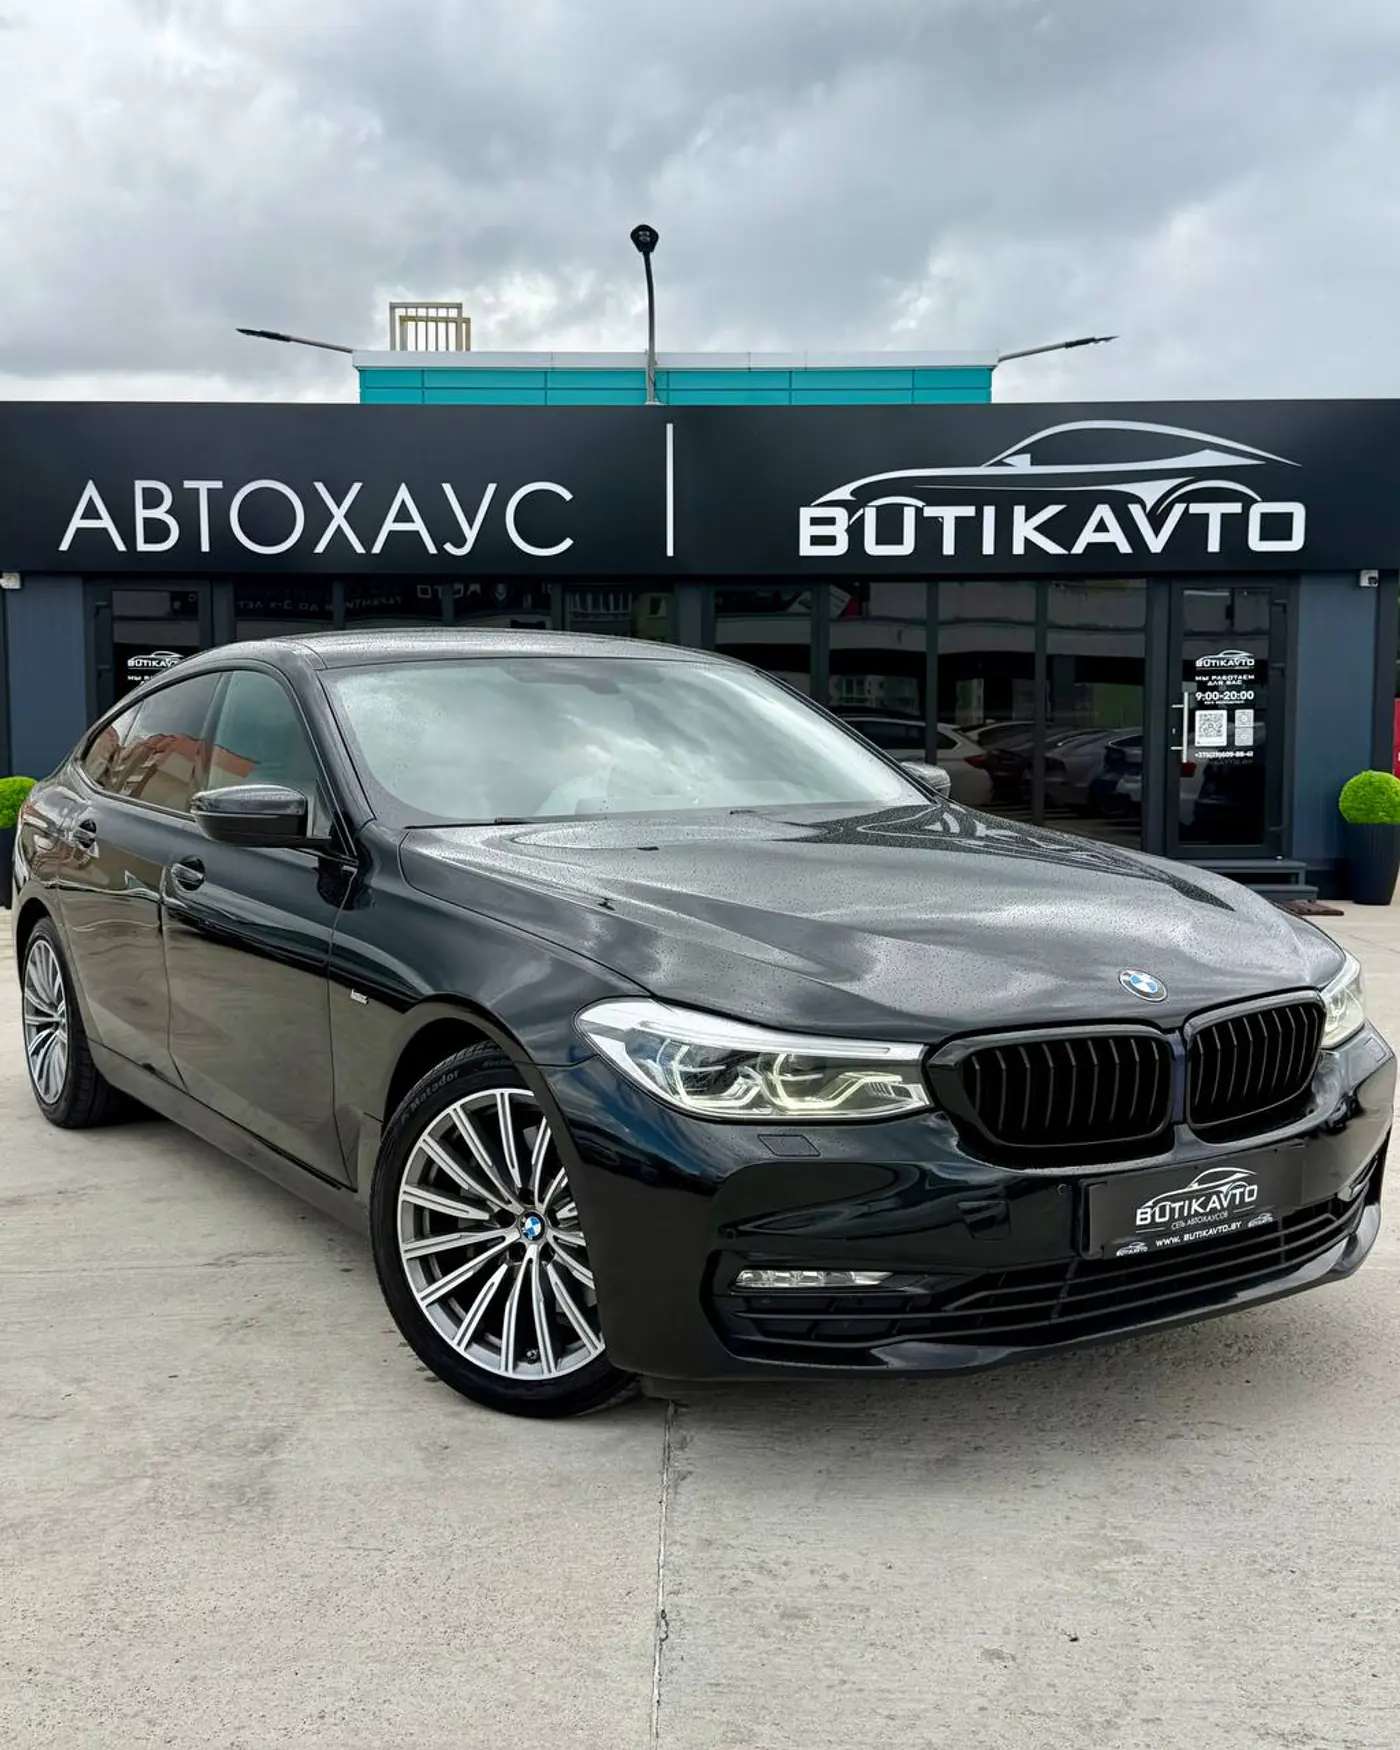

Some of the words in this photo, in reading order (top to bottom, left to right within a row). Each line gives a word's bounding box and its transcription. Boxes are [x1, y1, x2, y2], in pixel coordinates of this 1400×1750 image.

[58, 479, 574, 557] АВТОХАУС
[799, 500, 1307, 557] BUTIKAVTO
[1195, 659, 1255, 667] BUTIKAVTO
[1195, 691, 1255, 700] 9:00-20:00
[1135, 1185, 1258, 1226] BUTIKAVTO
[1183, 1221, 1242, 1241] BUTIKAVTO.BY
